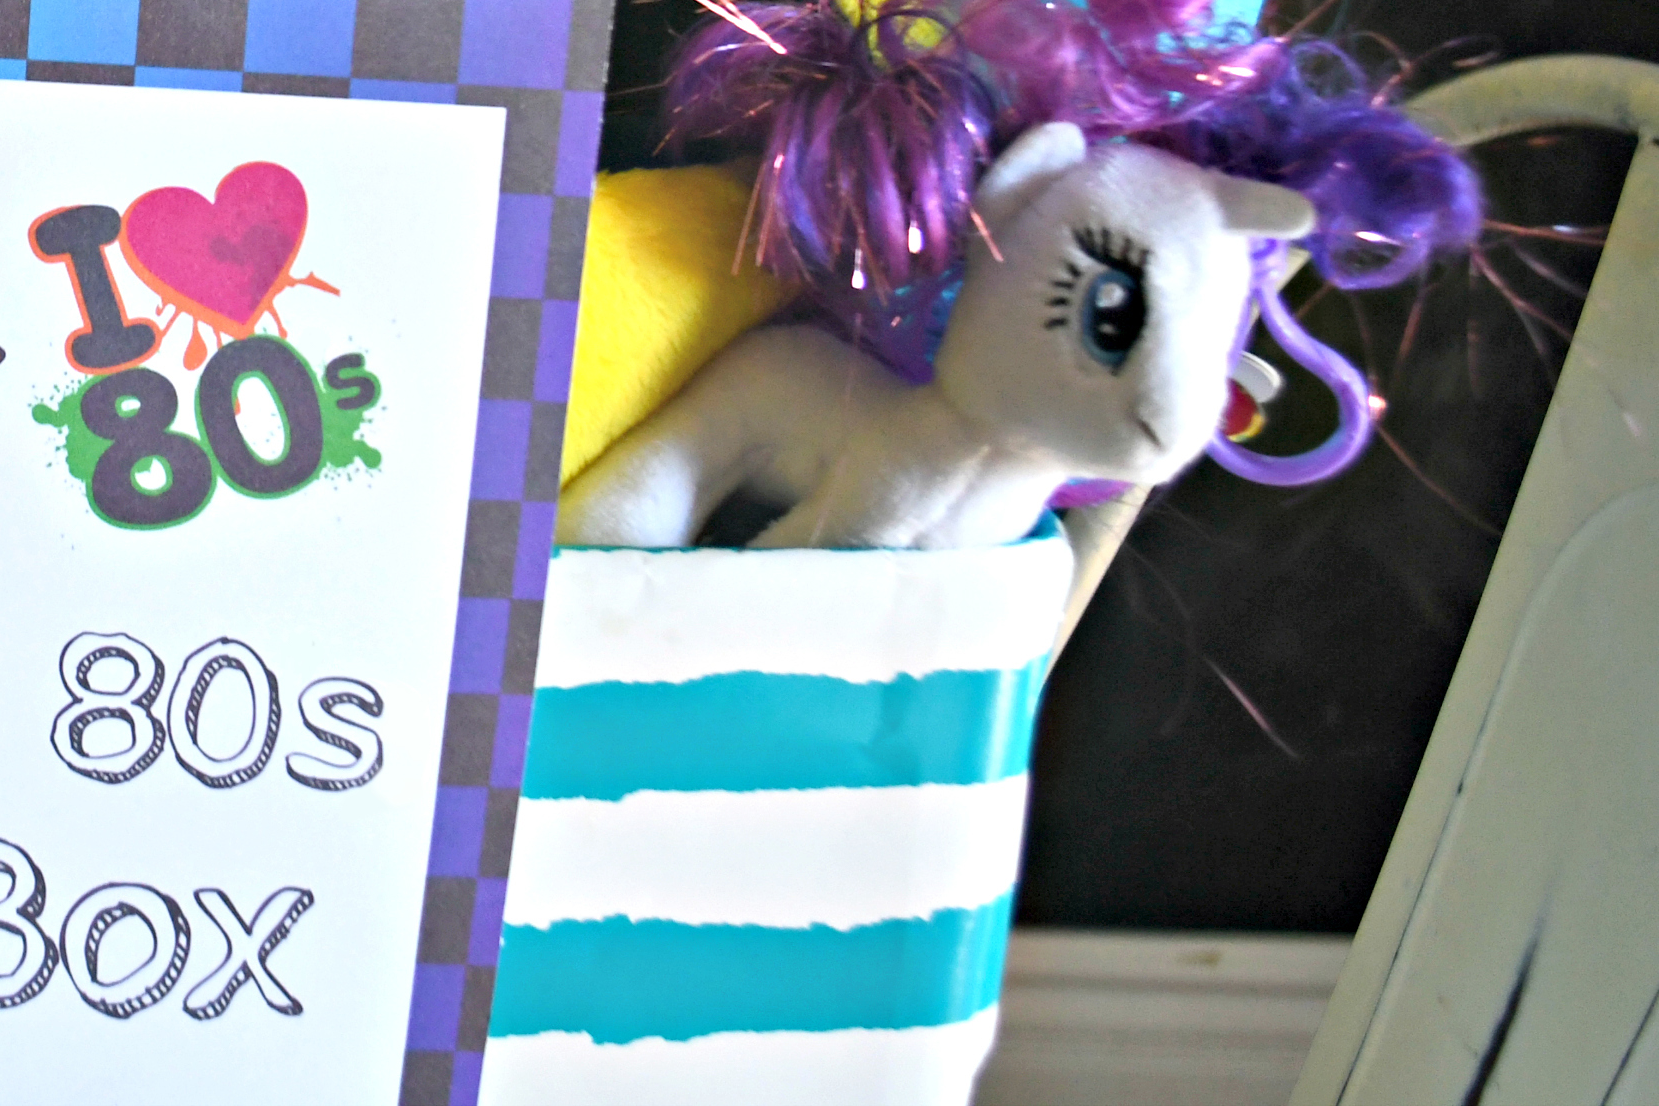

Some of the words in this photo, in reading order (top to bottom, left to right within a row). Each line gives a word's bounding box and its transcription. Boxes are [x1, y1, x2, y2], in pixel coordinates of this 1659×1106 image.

[31, 203, 159, 372] I
[77, 332, 379, 528] 80s
[49, 631, 384, 790] 80s
